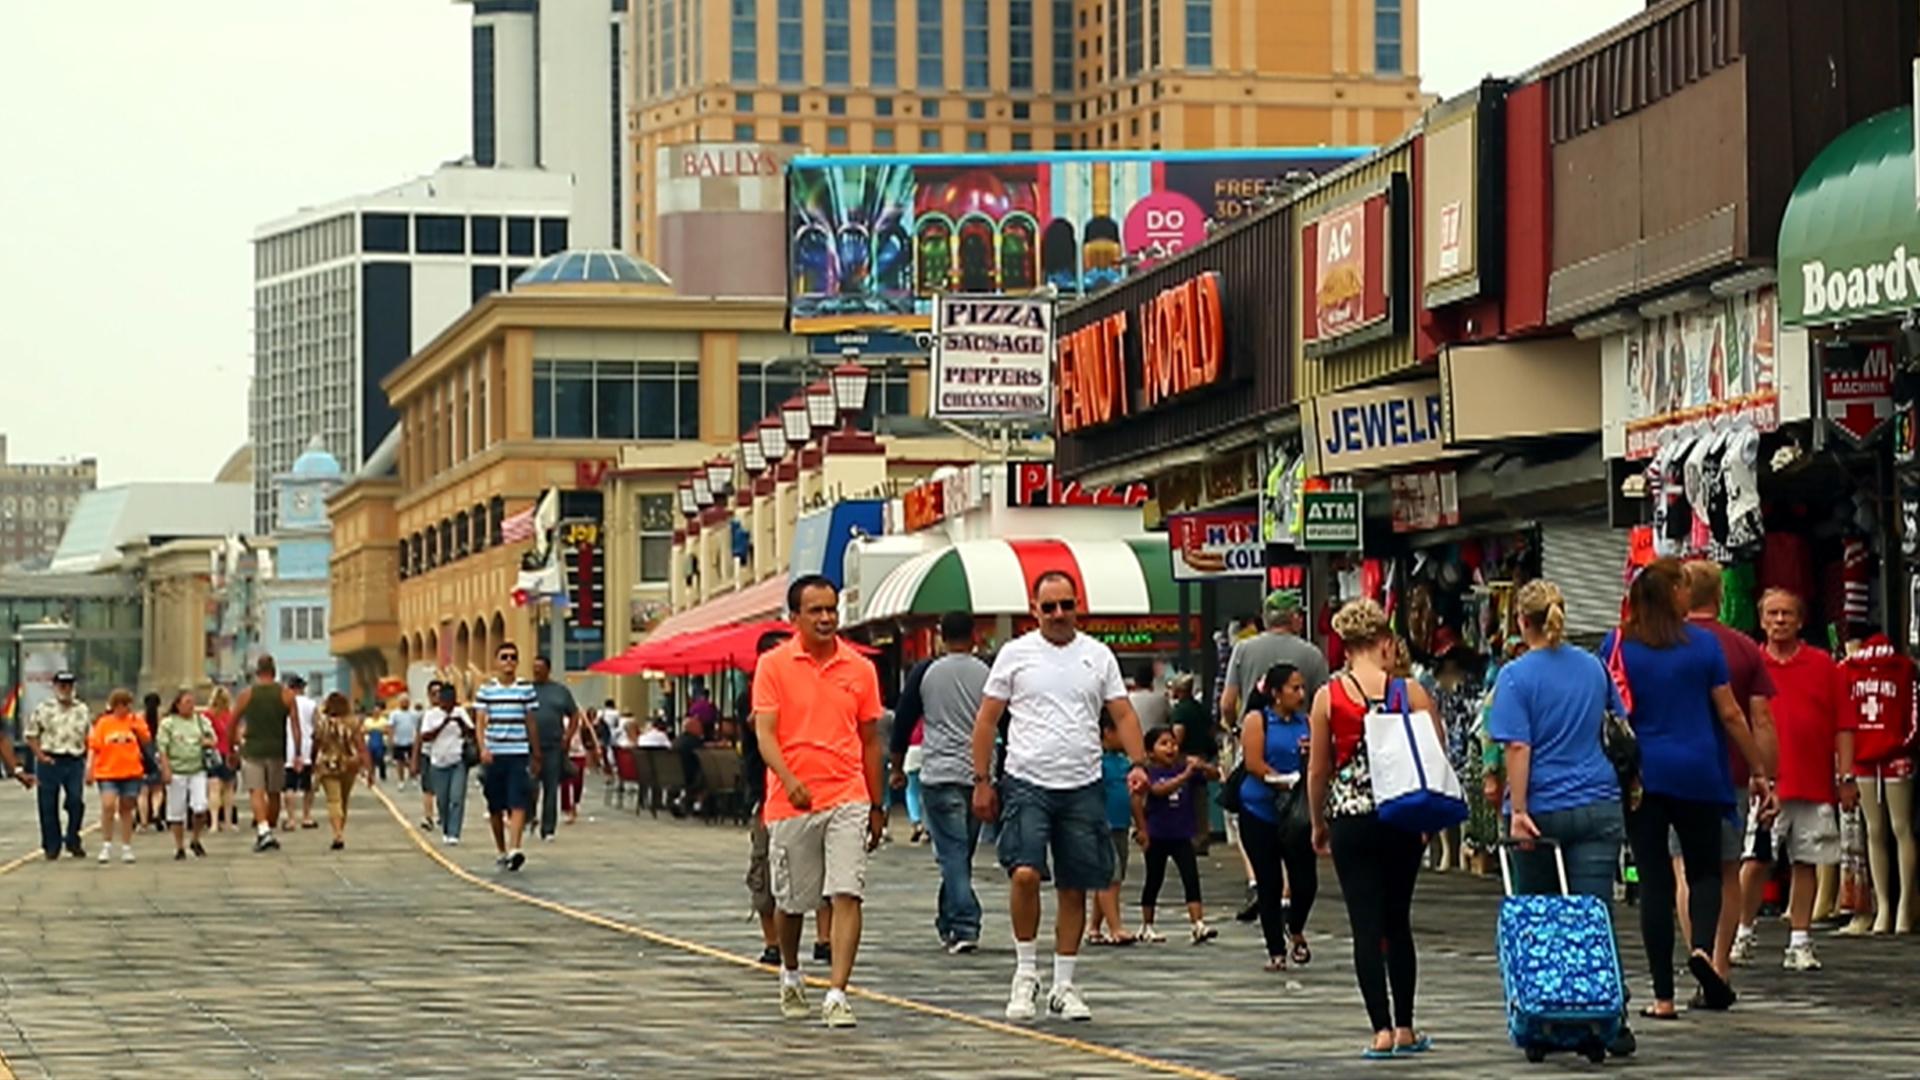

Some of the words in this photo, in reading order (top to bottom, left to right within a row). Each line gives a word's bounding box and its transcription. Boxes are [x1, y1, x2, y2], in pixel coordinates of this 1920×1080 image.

[1147, 211, 1184, 229] DO
[1327, 222, 1352, 262] AC
[945, 304, 1047, 332] PIZZA
[945, 334, 1044, 354] SAUSAGE
[1056, 310, 1128, 435] EANUT
[1140, 271, 1224, 406] WORLD
[945, 367, 1043, 386] PEPPERS
[1832, 381, 1886, 395] MACHINE
[1308, 502, 1355, 519] ATM
[1225, 550, 1264, 568] COL
